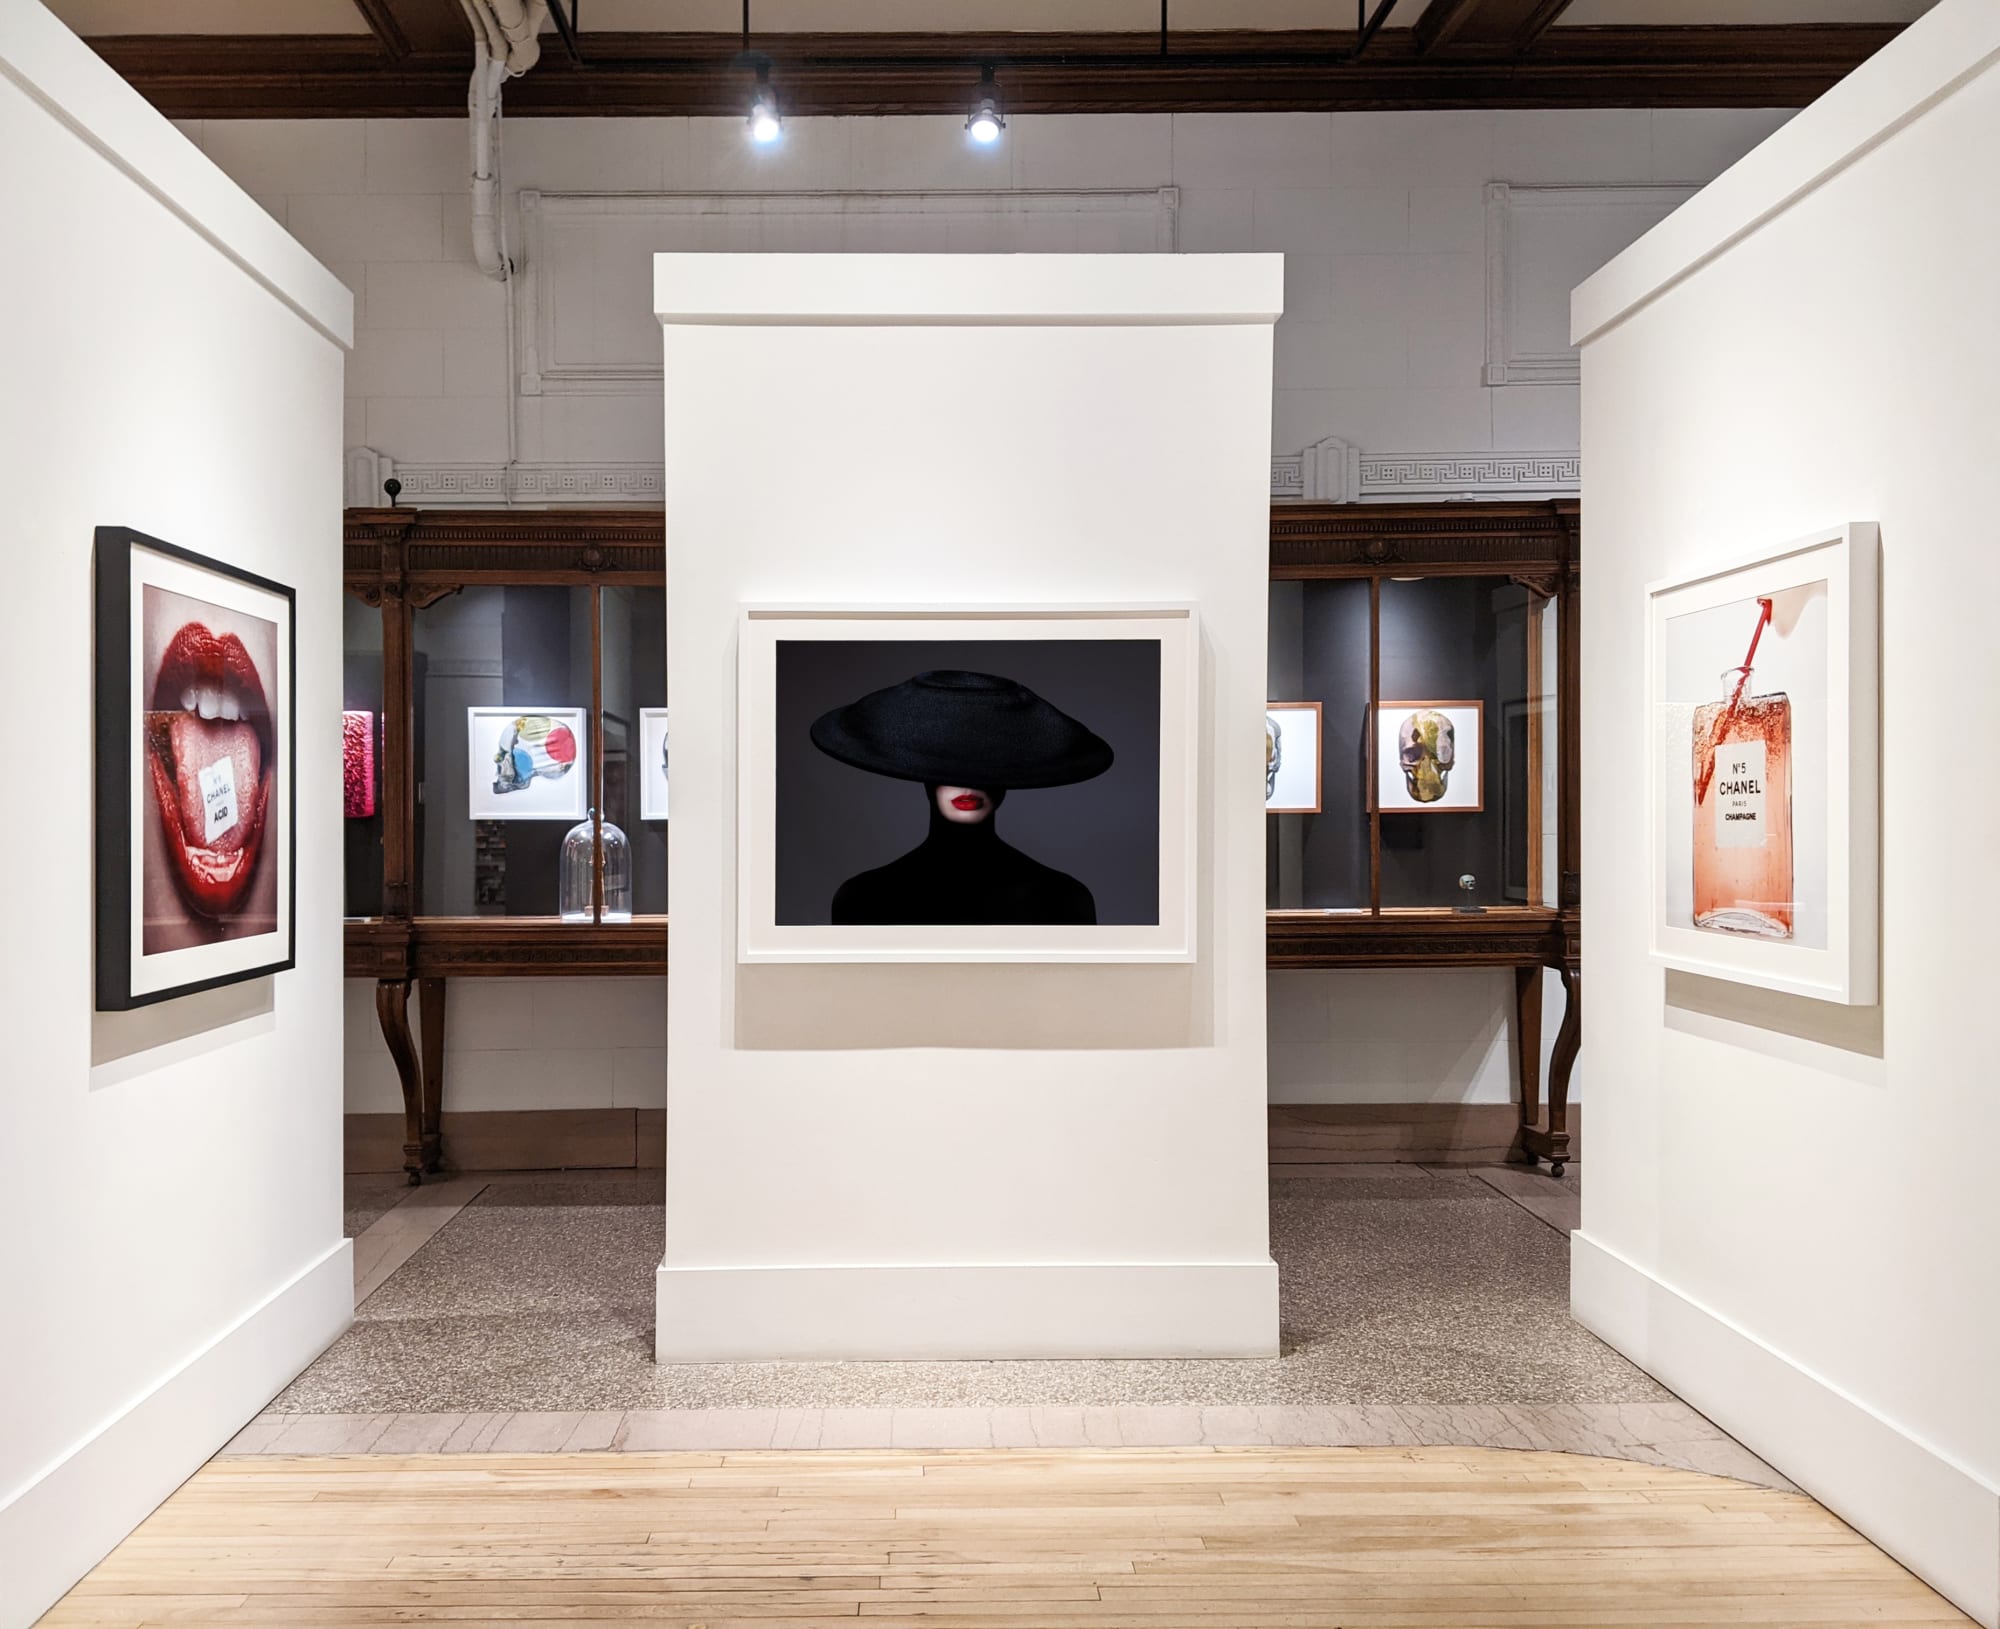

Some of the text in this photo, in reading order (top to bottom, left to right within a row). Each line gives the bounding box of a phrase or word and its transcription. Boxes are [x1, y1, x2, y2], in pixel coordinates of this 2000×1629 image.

[206, 783, 231, 804] CHANEL
[1719, 780, 1761, 796] CHANEL
[214, 806, 229, 823] ACID
[1725, 812, 1757, 821] CHAMPAGNE
